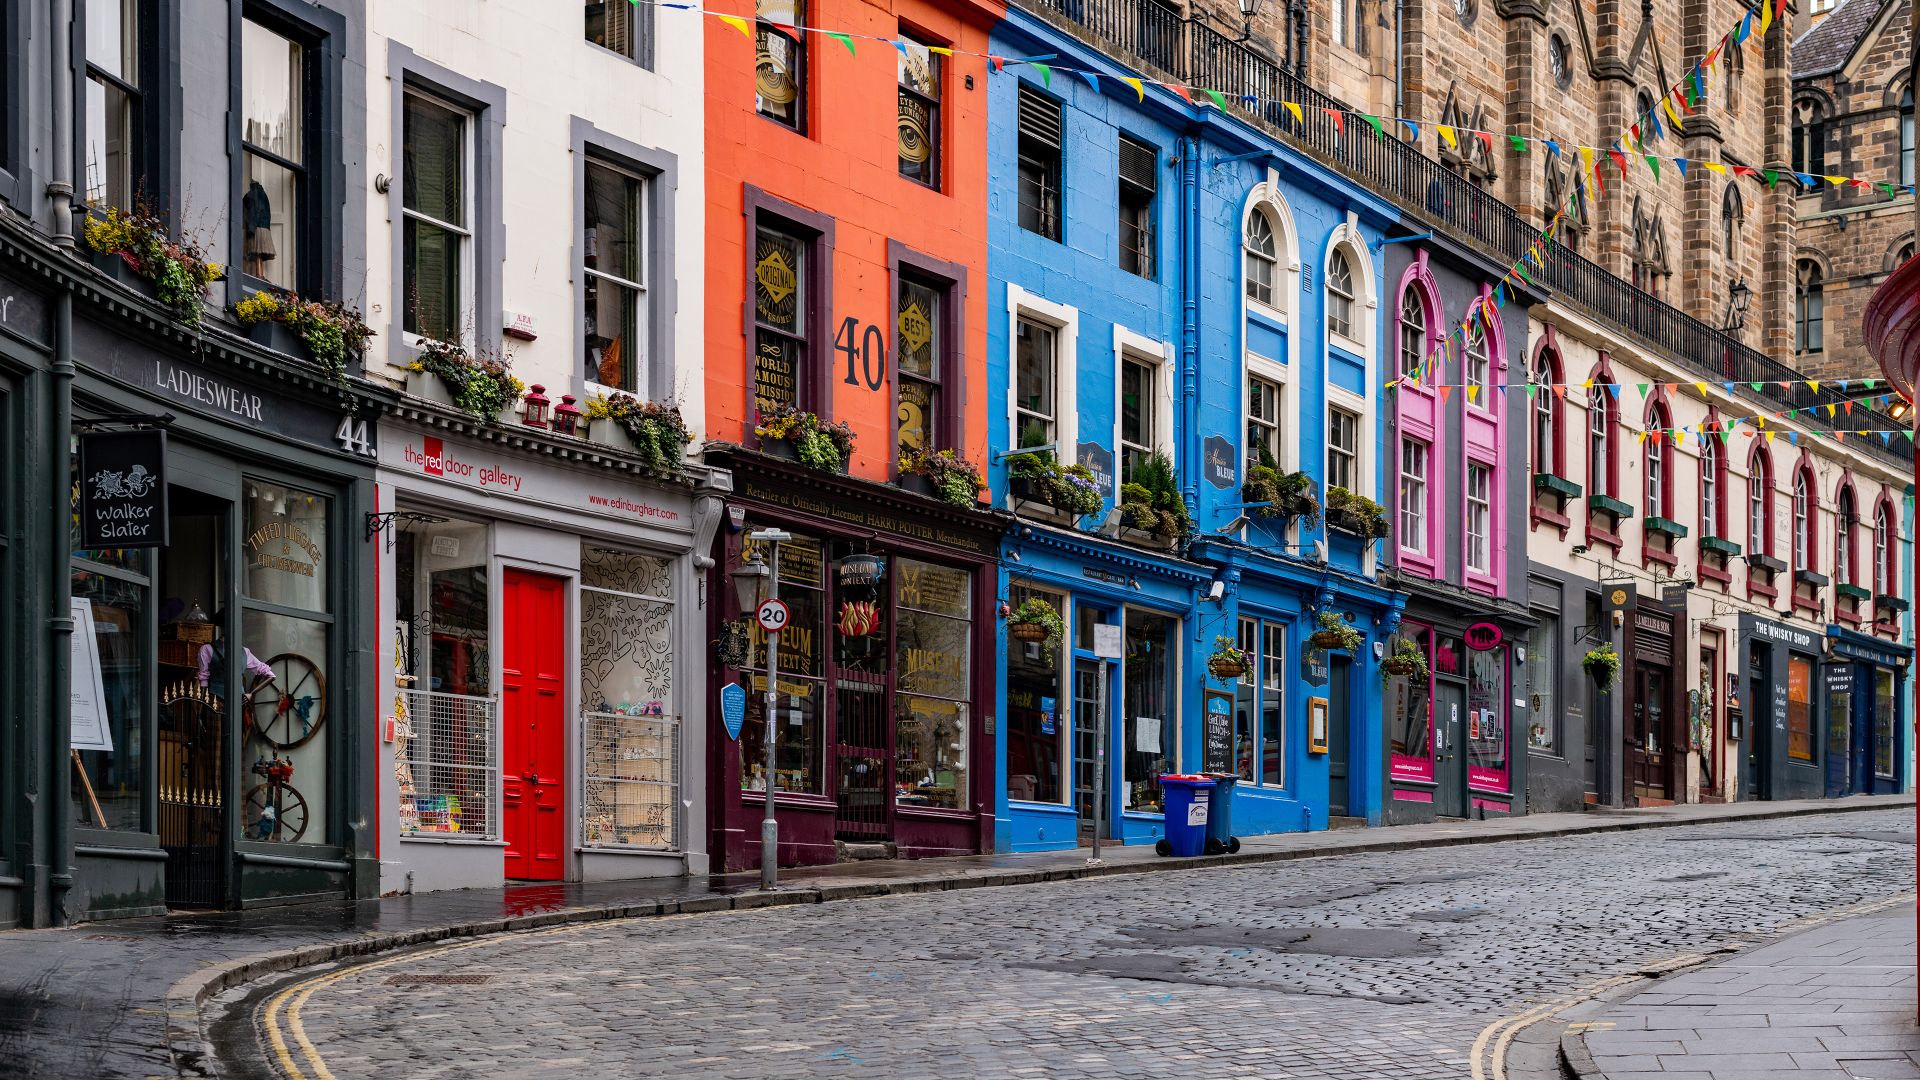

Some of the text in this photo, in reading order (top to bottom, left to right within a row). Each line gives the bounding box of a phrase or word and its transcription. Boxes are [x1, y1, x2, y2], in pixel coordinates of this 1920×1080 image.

[904, 106, 928, 129] UNIQUE
[760, 264, 793, 290] ORIGINAL
[904, 317, 925, 338] BEST
[834, 316, 884, 392] 40
[156, 361, 263, 422] LADIESWEAR
[755, 370, 794, 388] AMOUS!
[404, 444, 521, 491] the red door gallery
[1216, 465, 1235, 481] BLEUE
[589, 494, 679, 521] www.edinburghart.com
[746, 483, 779, 502] Retailer
[780, 496, 790, 505] of
[792, 495, 831, 518] Officially
[832, 504, 864, 523] Licensed
[867, 514, 898, 531] HARRY
[899, 519, 934, 540] POTTER
[248, 522, 281, 551] TWEED
[784, 552, 820, 567] HARRY POTTER
[761, 607, 785, 624] 20
[1755, 621, 1810, 647] THE WHISKY SHOP
[906, 647, 961, 680] MUSEUM
[1827, 675, 1853, 683] WHISKY
